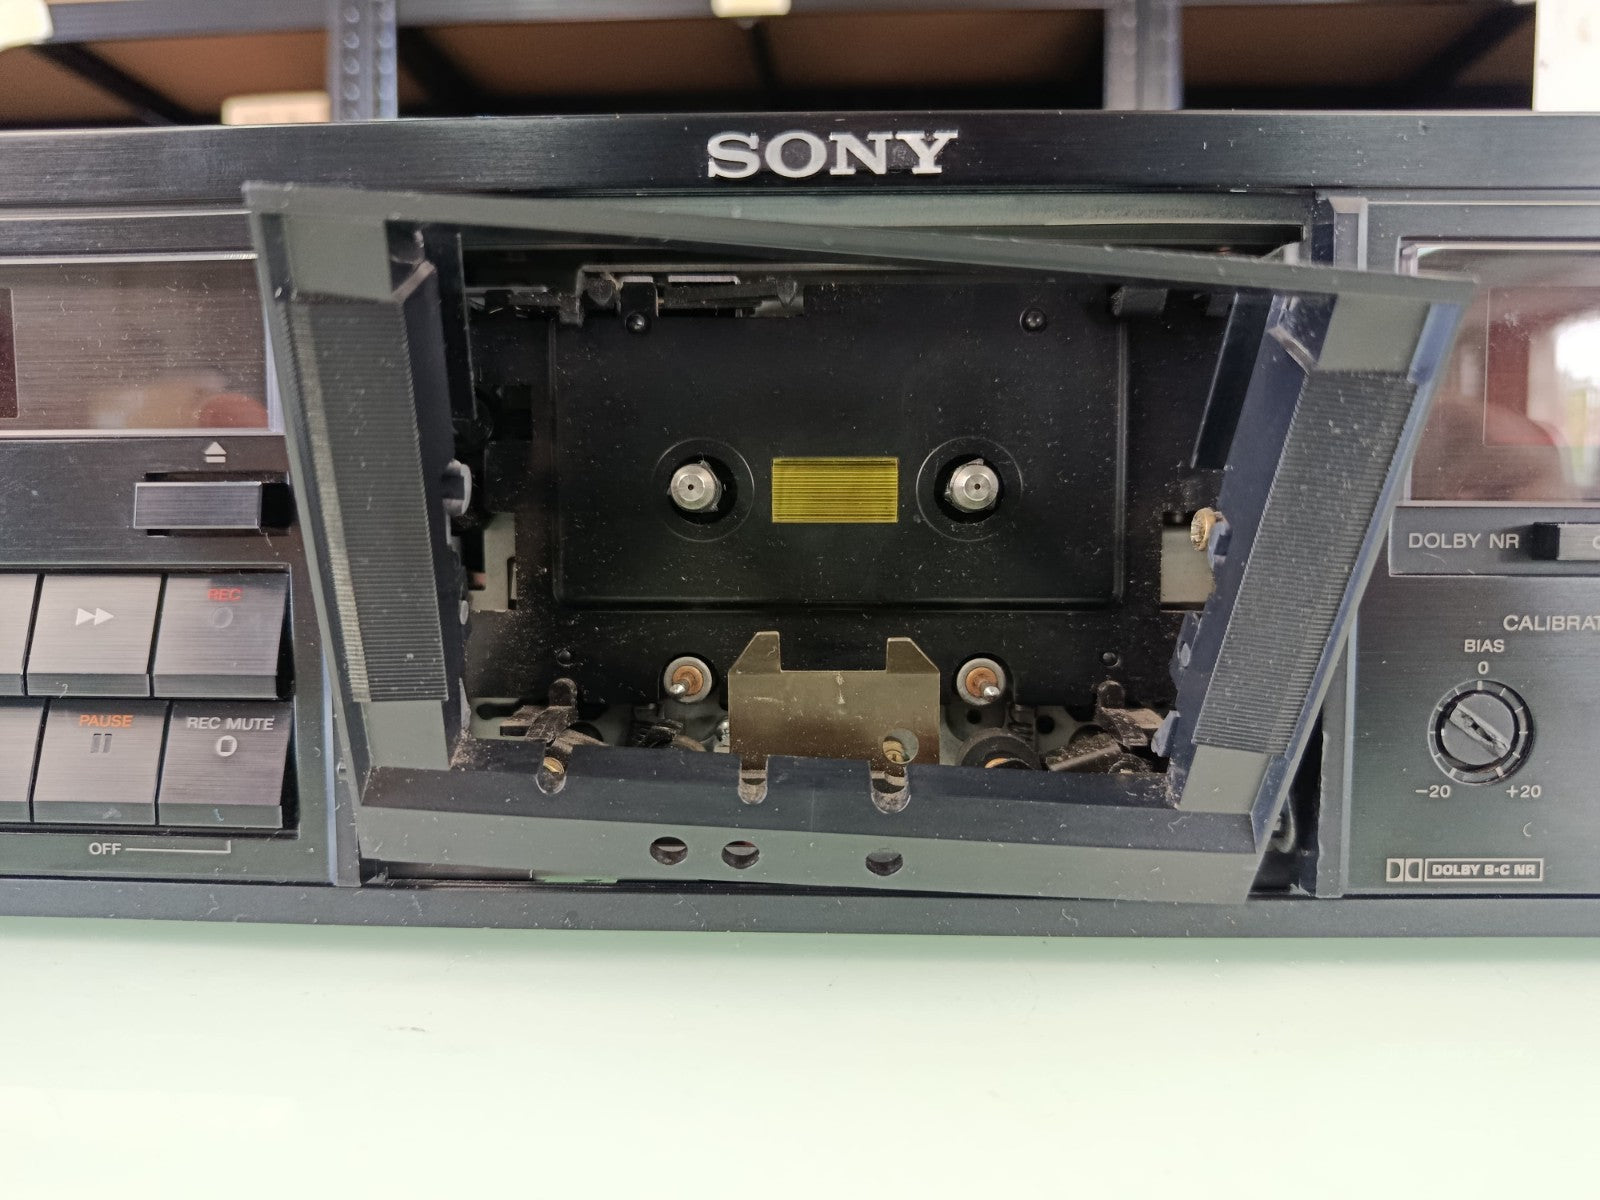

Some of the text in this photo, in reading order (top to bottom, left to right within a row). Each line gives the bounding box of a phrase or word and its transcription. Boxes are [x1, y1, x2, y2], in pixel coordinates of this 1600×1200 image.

[707, 130, 959, 178] SONY
[1408, 532, 1519, 549] DOLBY NR
[207, 588, 242, 601] REC
[1464, 639, 1504, 653] BIAS
[79, 714, 133, 728] PAUSE
[186, 716, 274, 731] REC MUTE
[1415, 784, 1451, 798] -20
[1506, 784, 1541, 798] +20
[88, 842, 121, 856] OFF
[1431, 863, 1481, 876] DOLBY
[1513, 863, 1536, 876] NR
